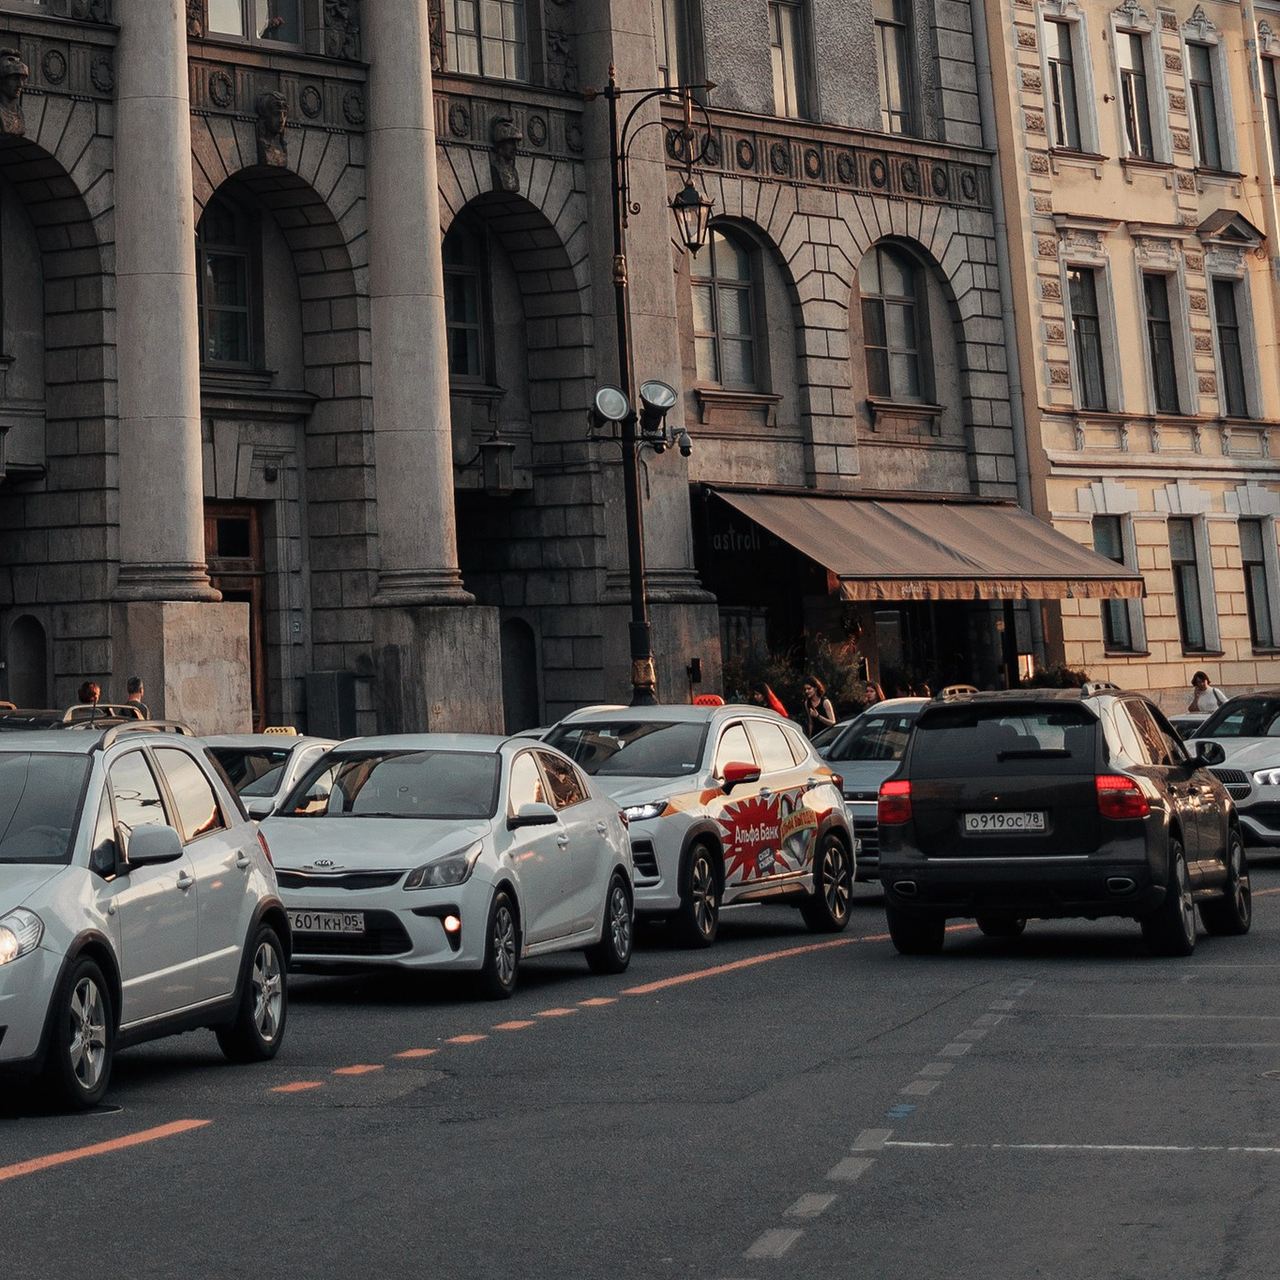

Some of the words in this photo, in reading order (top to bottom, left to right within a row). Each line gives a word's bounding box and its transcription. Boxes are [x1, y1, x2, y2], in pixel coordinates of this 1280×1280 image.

[708, 522, 761, 552] astroli
[1025, 813, 1040, 824] 78
[288, 914, 341, 931] 601КН
[344, 915, 359, 927] 05
